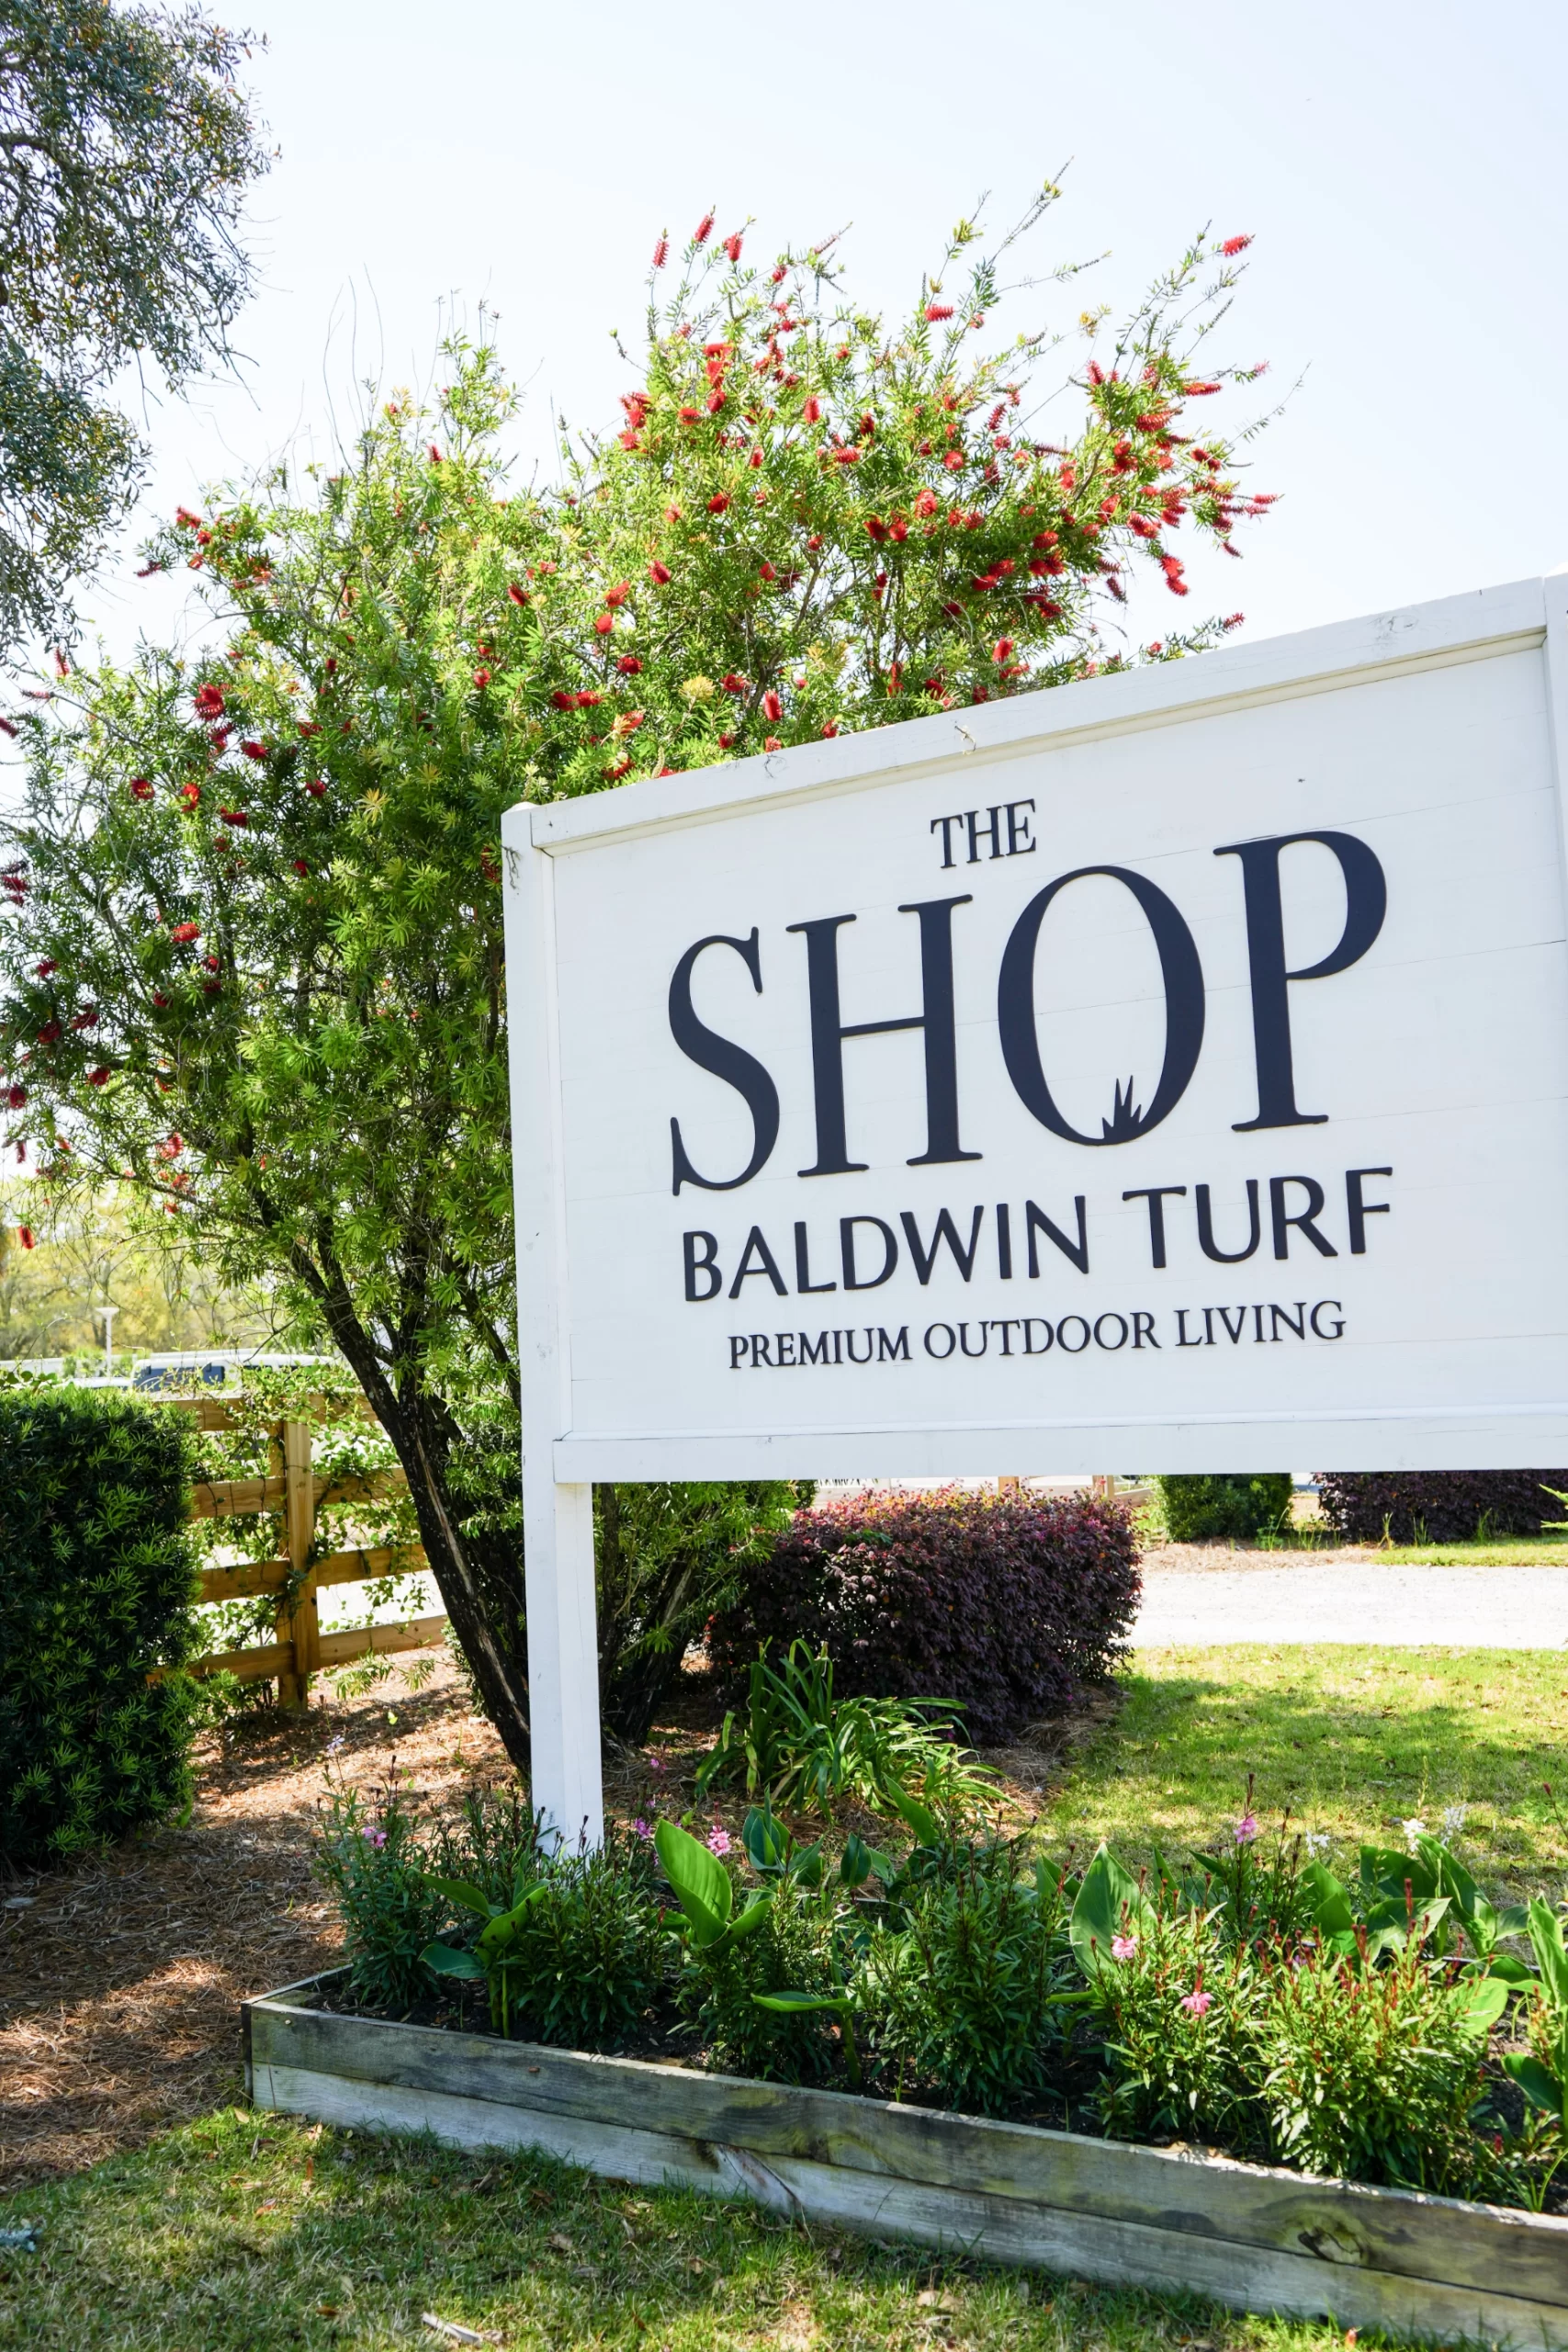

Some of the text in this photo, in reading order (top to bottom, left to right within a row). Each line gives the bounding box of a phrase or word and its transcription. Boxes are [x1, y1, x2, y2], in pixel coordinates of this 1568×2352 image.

[931, 798, 1037, 869] THE
[668, 831, 1388, 1198] SHOP
[682, 1167, 1394, 1303] BALDWIN TURF
[728, 1300, 1348, 1369] PREMIUM OUTDOOR LIVING
